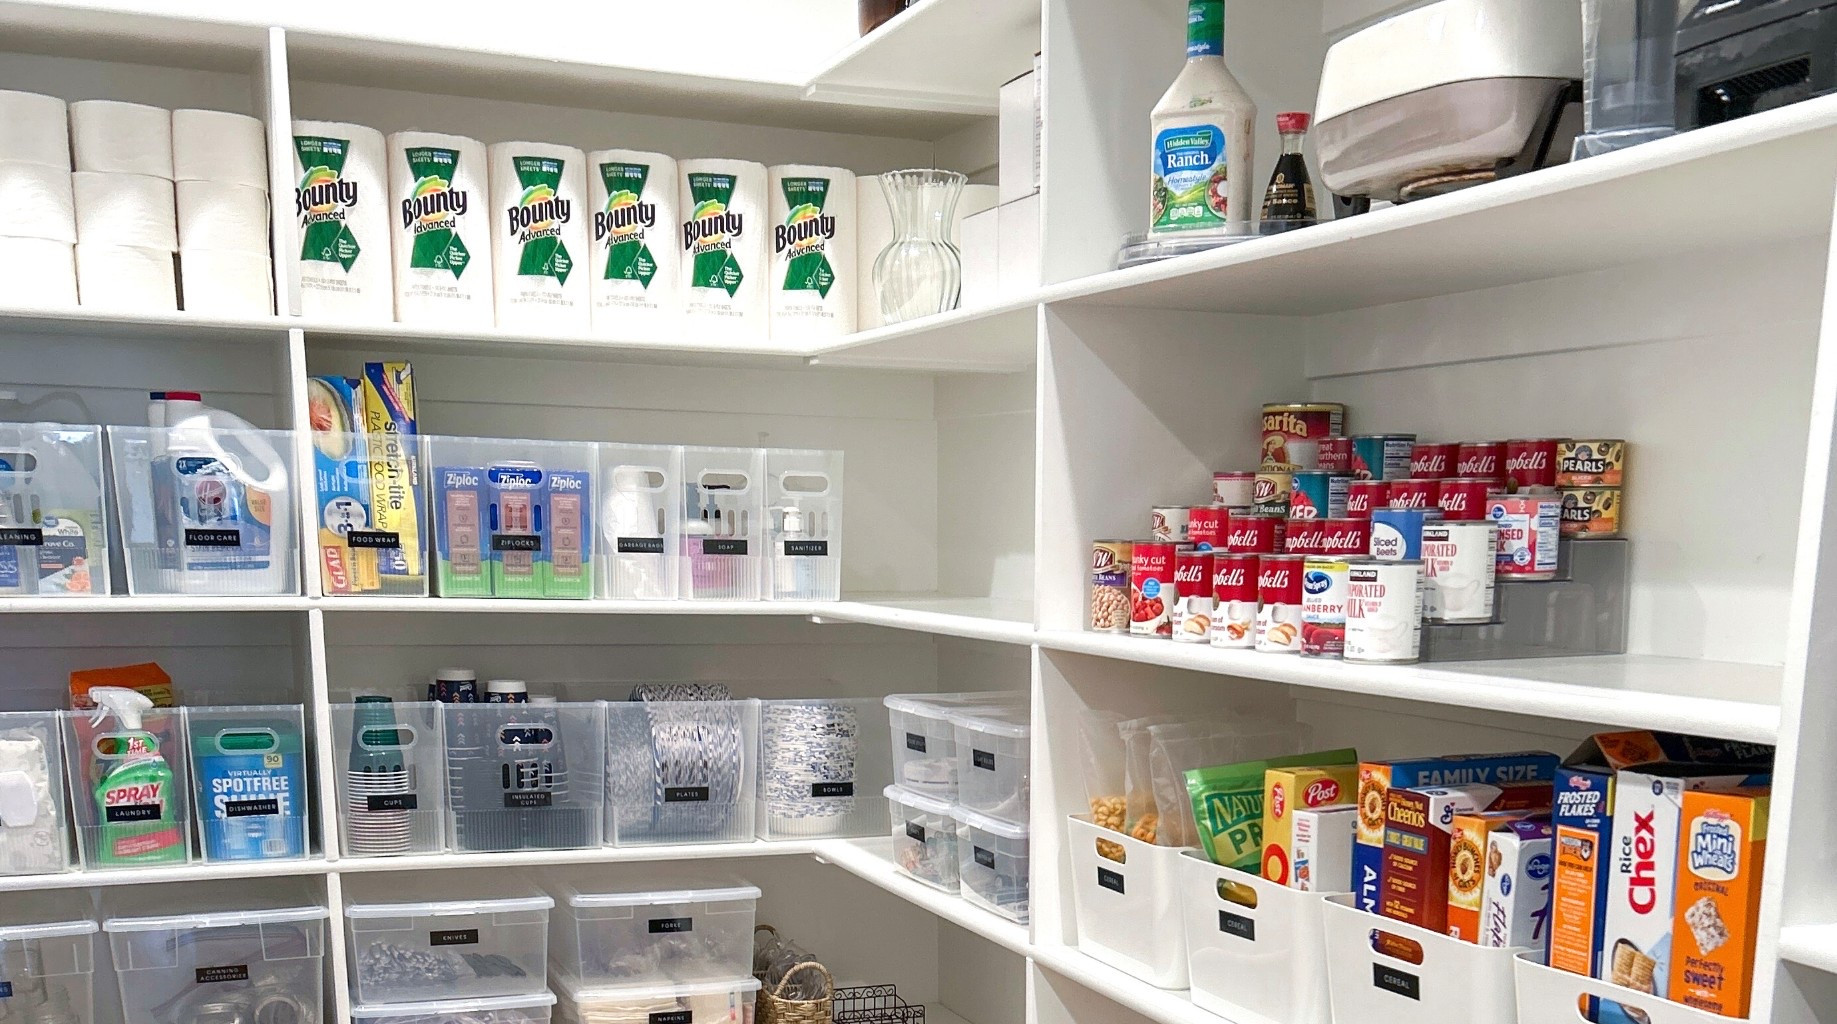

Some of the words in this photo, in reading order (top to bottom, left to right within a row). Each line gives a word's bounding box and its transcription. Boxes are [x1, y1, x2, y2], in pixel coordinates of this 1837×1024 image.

[1166, 138, 1190, 149] Hidden
[1191, 137, 1210, 146] Valley
[1167, 151, 1209, 169] Ranch
[1168, 174, 1207, 185] Homestyle
[295, 180, 358, 217] Bounty
[402, 187, 467, 229] Bounty
[508, 196, 571, 236] Bounty
[301, 209, 345, 228] Advanced
[594, 201, 656, 241] Bounty
[683, 210, 743, 250] Bounty
[775, 212, 836, 253] Bounty
[605, 229, 645, 249] Advanced
[1263, 412, 1308, 438] sarita
[1563, 460, 1604, 472] PEARLS
[446, 474, 478, 488] Ziploc
[500, 474, 533, 491] Ziploc
[551, 476, 582, 491] Ziploc
[375, 493, 388, 528] WRAP
[1563, 508, 1590, 520] ARLS
[1203, 520, 1219, 529] cut
[42, 540, 61, 548] rove
[790, 544, 822, 552] SANITIZER
[1374, 537, 1398, 547] Sliced
[1150, 556, 1166, 564] cut
[1376, 547, 1397, 556] Beets
[128, 737, 144, 748] 1ST
[228, 768, 272, 777] VIRTUALLY
[1418, 766, 1489, 786] FAMILY
[1496, 764, 1538, 782] SIZE
[212, 776, 289, 793] SPOTFREE
[823, 786, 844, 794] BOWLS
[1306, 780, 1337, 802] Post
[106, 782, 162, 806] SPRAY
[1274, 783, 1285, 818] Post
[1558, 791, 1600, 804] FROSTED
[228, 804, 276, 812] DISHWASHER
[1388, 802, 1426, 828] Cheerios
[1559, 804, 1596, 816] FLAKES
[1696, 833, 1735, 854] Mini
[1620, 835, 1632, 874] Rice
[1628, 810, 1657, 915] Chex
[1692, 850, 1736, 874] Wheats
[1104, 875, 1119, 886] CEREAL
[1226, 918, 1248, 932] CEREAL
[442, 934, 468, 942] KNIVES
[1383, 974, 1410, 989] CEREAL
[1684, 969, 1724, 991] sweet
